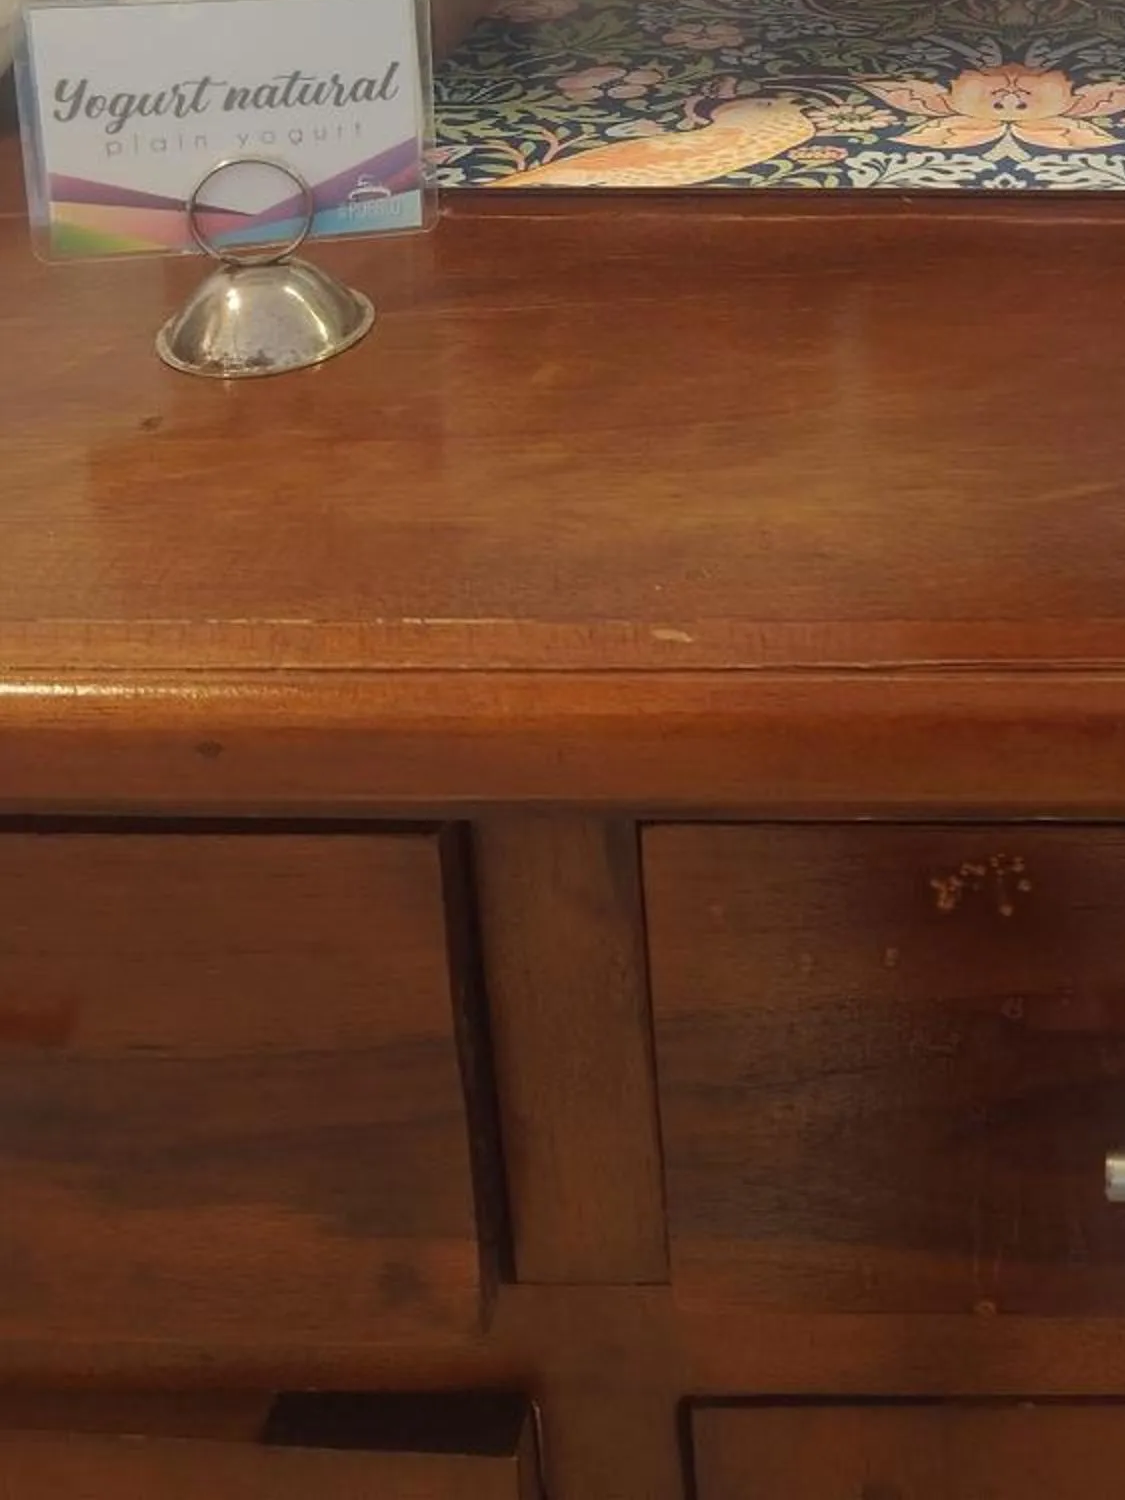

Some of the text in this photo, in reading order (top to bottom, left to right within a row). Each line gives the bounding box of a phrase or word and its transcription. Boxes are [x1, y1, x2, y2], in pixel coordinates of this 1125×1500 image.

[52, 60, 400, 135] Yogurt natural
[105, 121, 362, 158] plain yogurt
